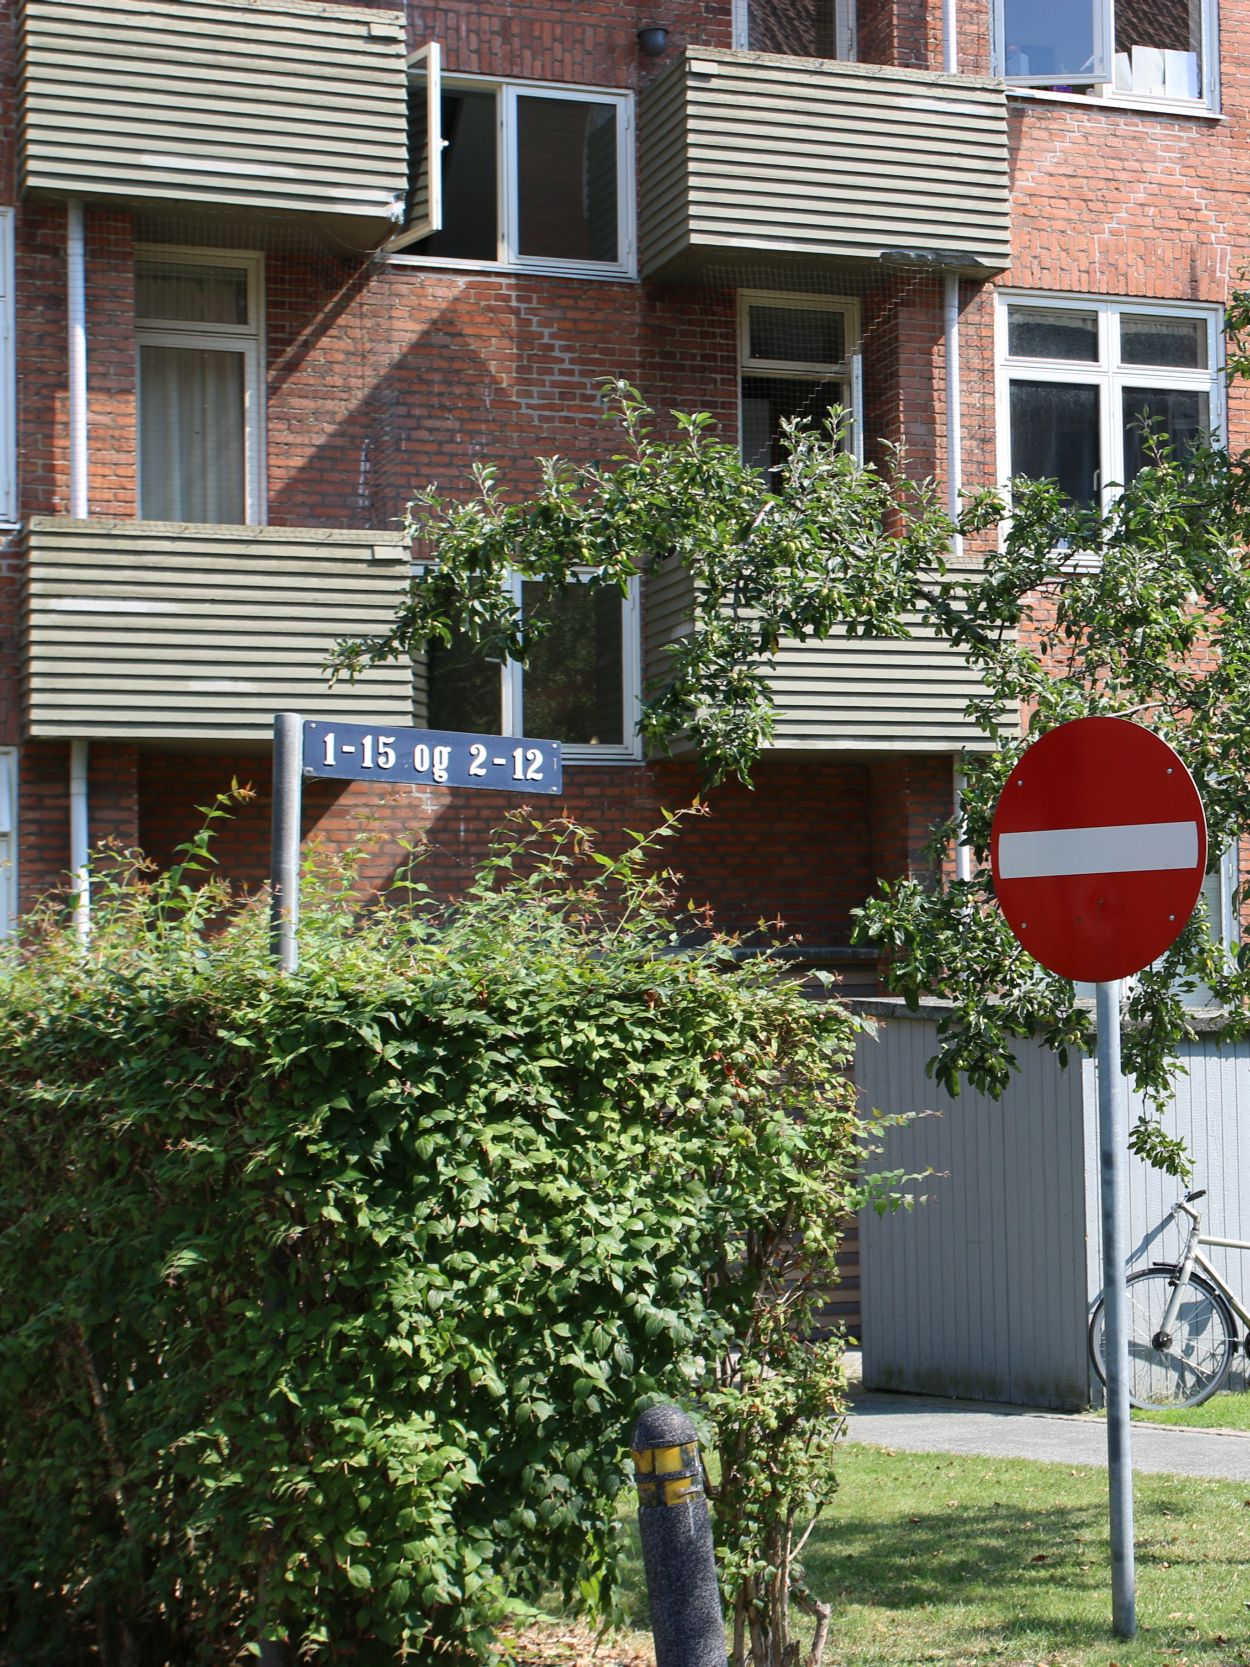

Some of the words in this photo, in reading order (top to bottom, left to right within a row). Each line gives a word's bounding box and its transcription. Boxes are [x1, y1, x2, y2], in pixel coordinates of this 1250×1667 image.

[323, 733, 396, 769] 1-15
[413, 744, 452, 783] og
[468, 743, 544, 781] 2-12
